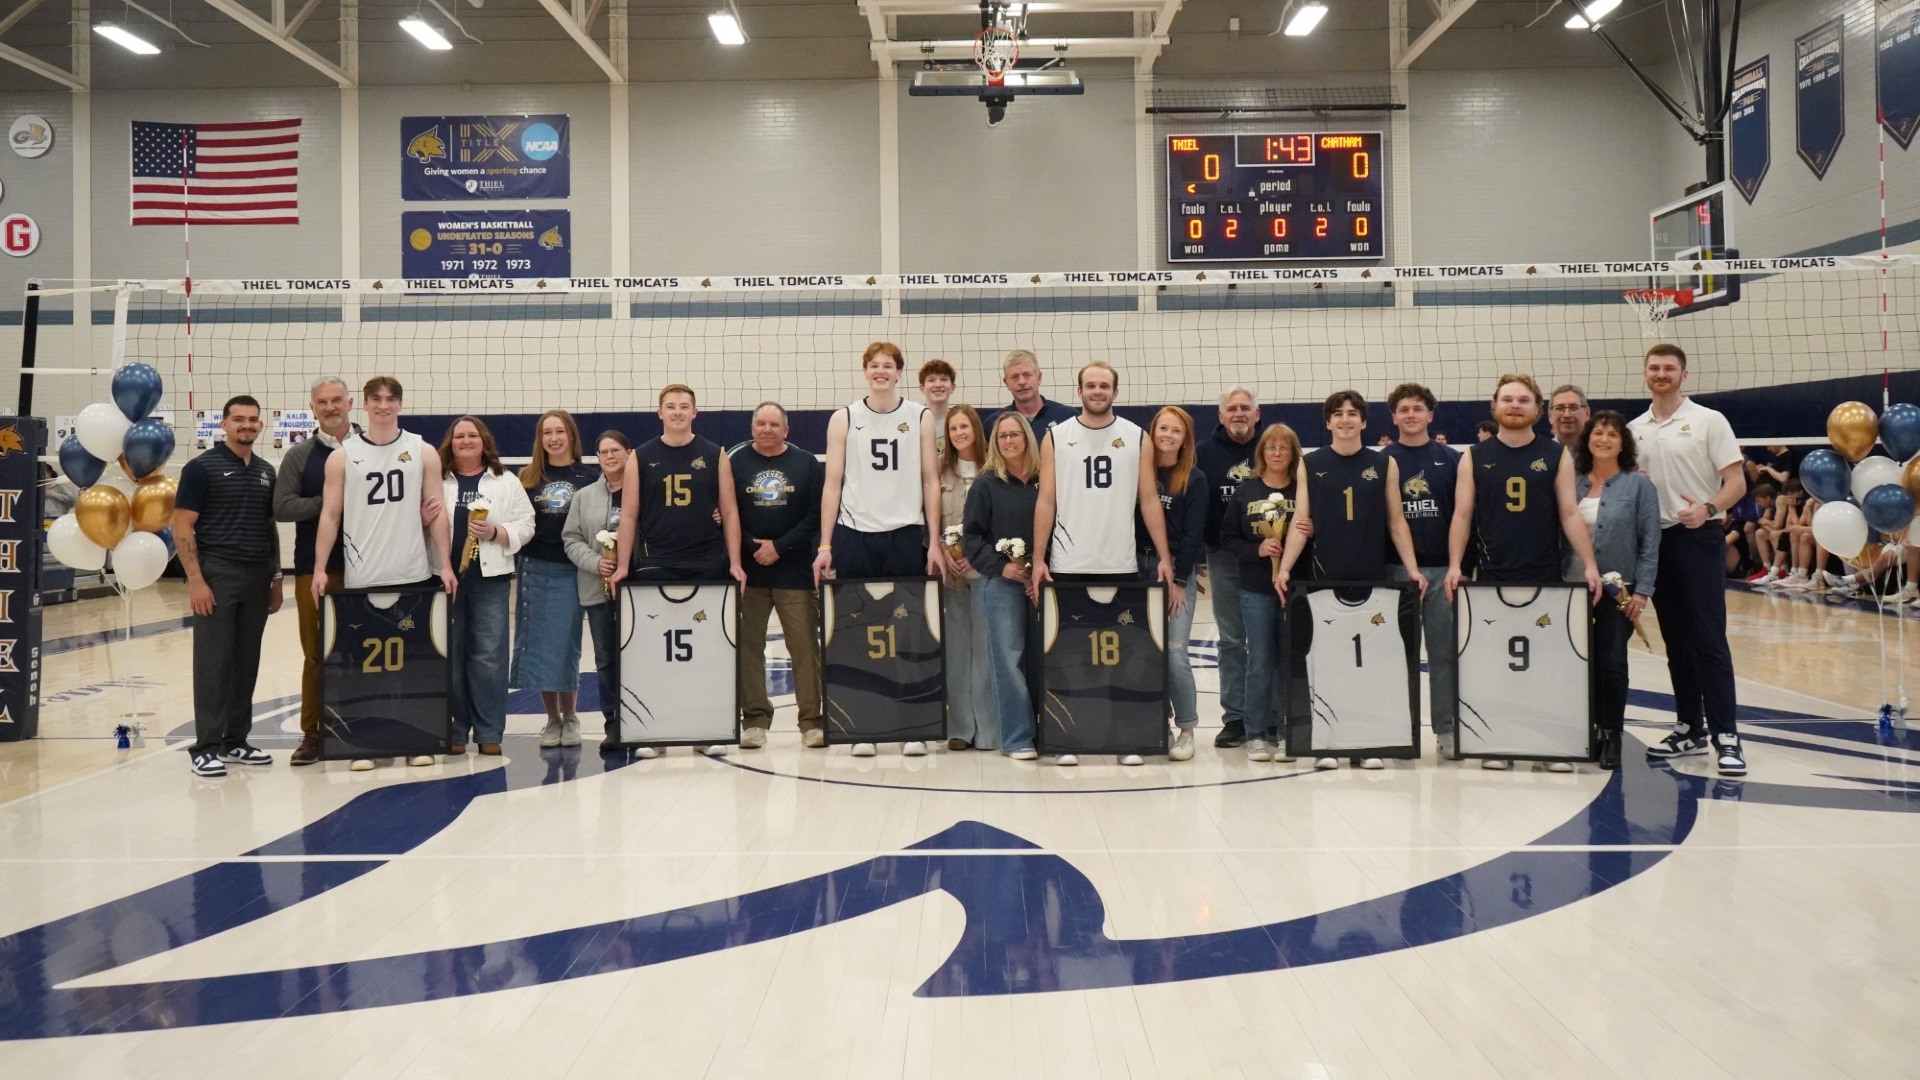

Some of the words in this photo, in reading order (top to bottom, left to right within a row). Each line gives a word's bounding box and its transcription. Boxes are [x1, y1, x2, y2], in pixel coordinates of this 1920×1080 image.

[460, 139, 500, 147] TITLE
[525, 140, 558, 152] NCAA
[1173, 139, 1199, 151] THIEL
[1266, 135, 1311, 162] 1:43
[1321, 136, 1362, 149] CHATHAM
[424, 167, 449, 177] Giving
[450, 168, 479, 176] women
[486, 167, 518, 176] sporting
[519, 166, 547, 175] chance
[1204, 154, 1220, 180] 0
[1353, 152, 1368, 178] 0
[1260, 179, 1291, 193] period
[1181, 203, 1205, 215] fouls
[1259, 201, 1292, 215] player
[1347, 200, 1371, 212] fouls
[438, 222, 479, 230] WOMEN'S
[480, 221, 533, 230] BASKETBALL
[1190, 219, 1202, 239] 0
[1226, 218, 1238, 238] 2
[1274, 218, 1286, 238] 0
[1316, 217, 1328, 237] 2
[1356, 217, 1368, 236] 0
[5, 218, 31, 252] G
[437, 232, 493, 241] UNDEFEATED
[495, 231, 535, 240] SEASONS
[468, 242, 503, 255] 31-0
[1184, 244, 1204, 254] won
[1264, 244, 1290, 255] game
[1350, 242, 1370, 252] won
[440, 260, 465, 270] 1971
[472, 260, 498, 270] 1972
[505, 259, 531, 270] 1973
[1559, 264, 1600, 274] THIEL
[1605, 263, 1669, 273] TOMCATS
[1725, 260, 1766, 270] THIEL
[1771, 257, 1836, 269] TOMCATS
[1064, 273, 1104, 282] THIEL
[1109, 272, 1173, 282] TOMCATS
[1229, 270, 1269, 280] THIEL
[1274, 269, 1338, 279] TOMCATS
[1394, 268, 1434, 277] THIEL
[1439, 266, 1503, 277] TOMCATS
[241, 280, 283, 290] THIEL
[286, 280, 351, 290] TOMCATS
[405, 279, 446, 289] THIEL
[450, 279, 514, 289] TOMCATS
[569, 279, 610, 288] THIEL
[614, 278, 679, 288] TOMCATS
[734, 277, 774, 287] THIEL
[779, 276, 843, 286] TOMCATS
[900, 275, 939, 284] THIEL
[944, 274, 1008, 284] TOMCATS
[871, 438, 898, 471] 51
[1083, 455, 1112, 488] 18
[366, 468, 405, 505] 20
[663, 474, 692, 507] 15
[1505, 476, 1526, 512] 9
[1343, 486, 1354, 521] 1
[1405, 511, 1439, 519] LLEYBALL
[663, 629, 693, 662] 15
[867, 624, 896, 660] 51
[1088, 630, 1120, 666] 18
[362, 636, 404, 673] 20
[1352, 633, 1363, 667] 1
[1508, 635, 1529, 672] 9
